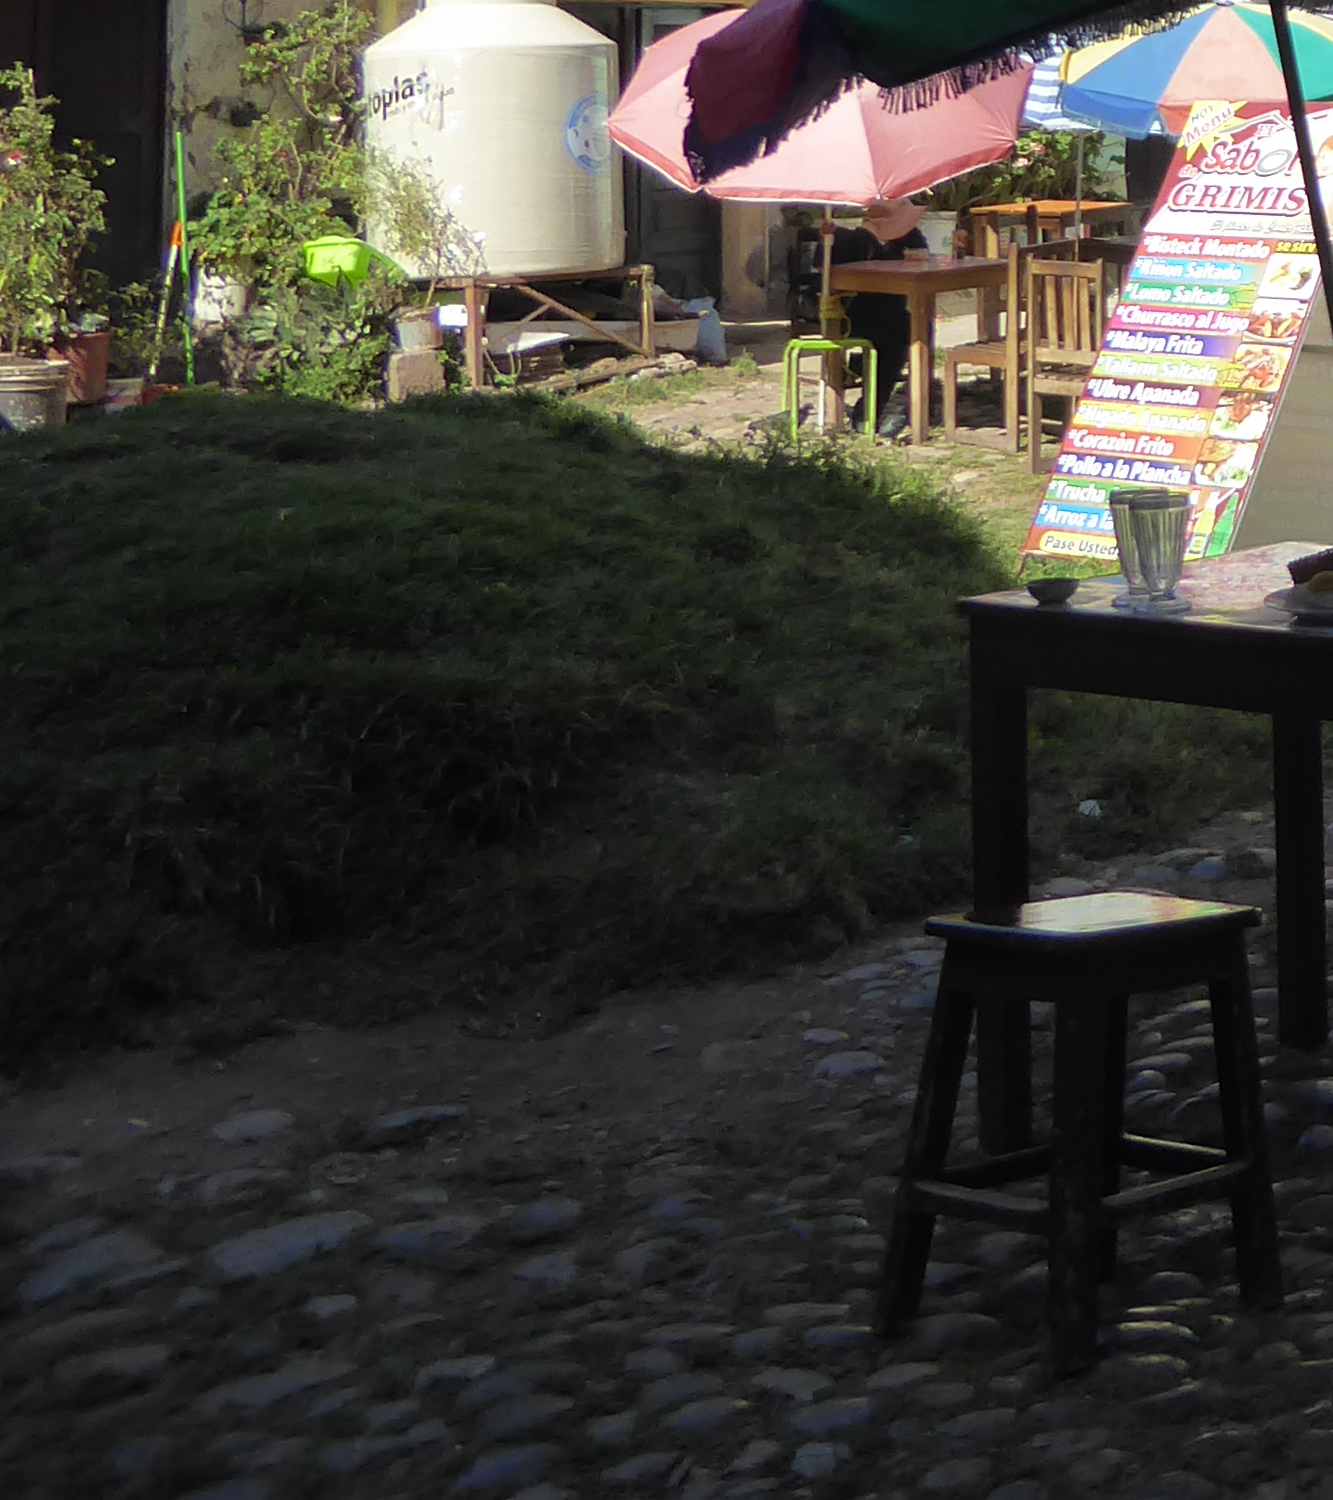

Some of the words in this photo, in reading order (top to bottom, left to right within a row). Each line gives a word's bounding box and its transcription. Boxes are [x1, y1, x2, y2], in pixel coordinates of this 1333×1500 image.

[1171, 182, 1307, 212] GRIMIS
[1202, 238, 1270, 259] Montado
[1291, 239, 1318, 253] sirv
[1186, 259, 1243, 281] Saltado
[1130, 282, 1172, 302] Lomo
[1172, 283, 1230, 306] Saltado
[1121, 305, 1196, 328] Churrasco
[1195, 311, 1210, 329] al
[1209, 311, 1250, 335] Jugo
[1110, 331, 1165, 354] Malaya
[1165, 334, 1205, 356] Frita
[1160, 358, 1218, 382] Saltado
[1092, 378, 1131, 400] Ubre
[1130, 382, 1200, 406] Apanada
[1137, 408, 1207, 433] Apanado
[1134, 435, 1175, 457] Frito
[1061, 454, 1102, 477] Pollo
[1101, 463, 1114, 477] a
[1113, 458, 1131, 480] la
[1130, 461, 1192, 486] Plancha
[1054, 480, 1107, 504] Trucha
[1042, 503, 1088, 527] Arroz
[1086, 514, 1099, 528] a
[1044, 534, 1075, 550] Pase
